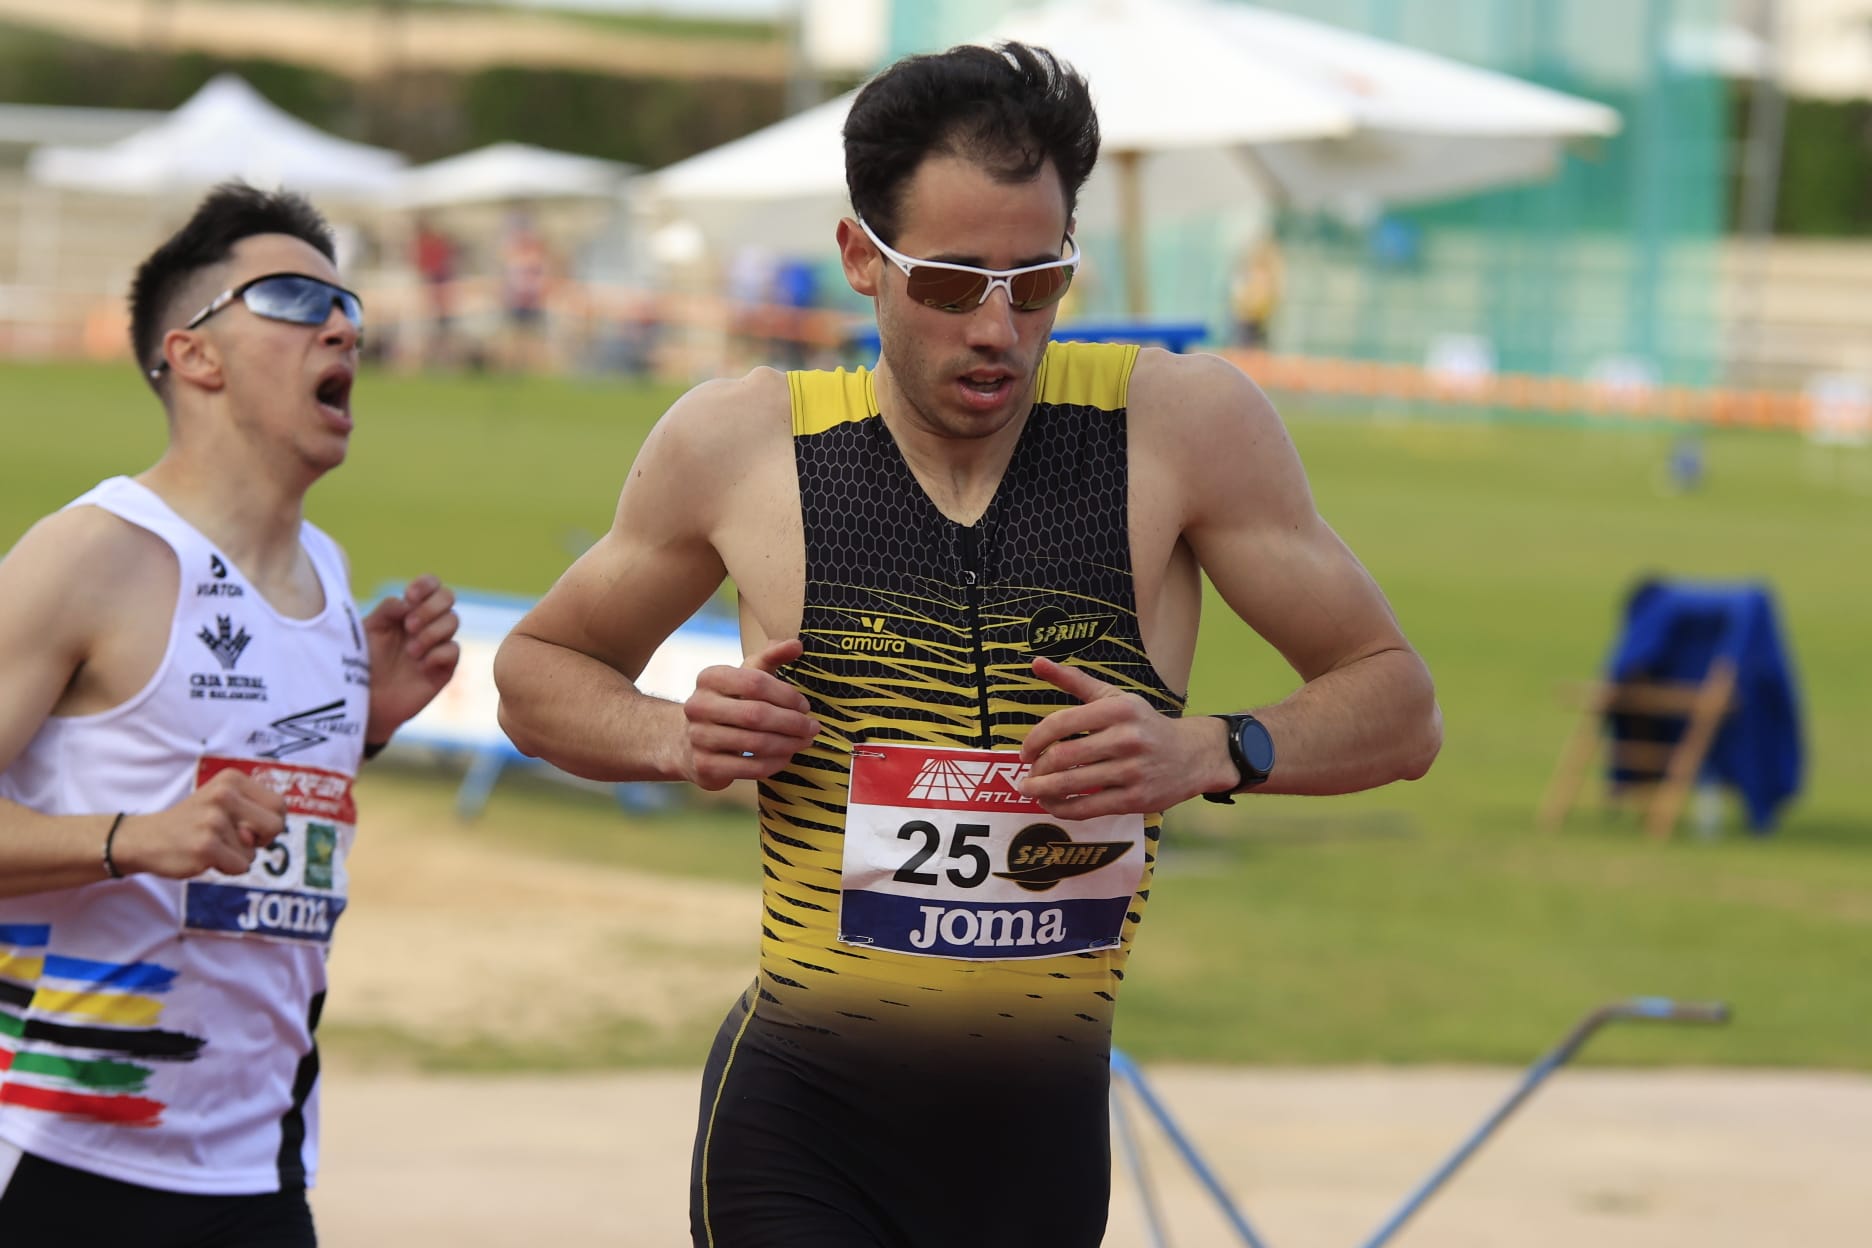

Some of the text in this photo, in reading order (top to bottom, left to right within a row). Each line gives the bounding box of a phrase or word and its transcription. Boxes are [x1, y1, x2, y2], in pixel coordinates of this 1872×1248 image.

[1033, 621, 1098, 643] SPRINT
[841, 636, 905, 653] amura
[893, 821, 990, 888] 25
[1011, 844, 1109, 866] SPRINT
[909, 904, 1066, 948] Joma
